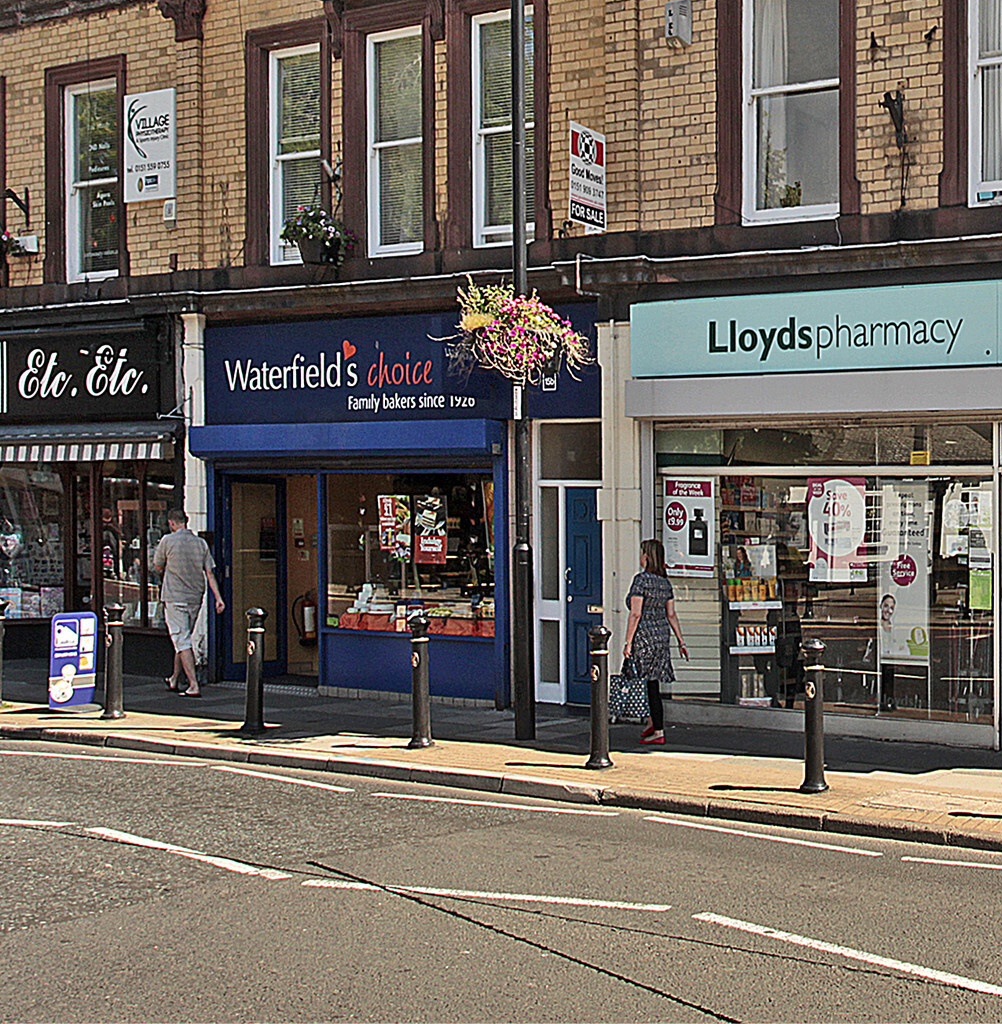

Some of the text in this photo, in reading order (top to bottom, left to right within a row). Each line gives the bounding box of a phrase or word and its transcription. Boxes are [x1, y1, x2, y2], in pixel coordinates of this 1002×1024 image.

[135, 114, 169, 129] VILLAGE
[571, 163, 585, 179] Good
[571, 202, 604, 225] FOR SALE
[708, 314, 964, 362] Lloydspharmacy
[18, 344, 148, 399] Etc. Etc.
[367, 351, 433, 388] choice
[347, 393, 381, 414] Family
[382, 392, 416, 410] bakers
[418, 392, 445, 408] since
[826, 490, 848, 501] Save
[667, 507, 684, 519] Only
[822, 501, 852, 517] 40%
[892, 569, 915, 578] Service
